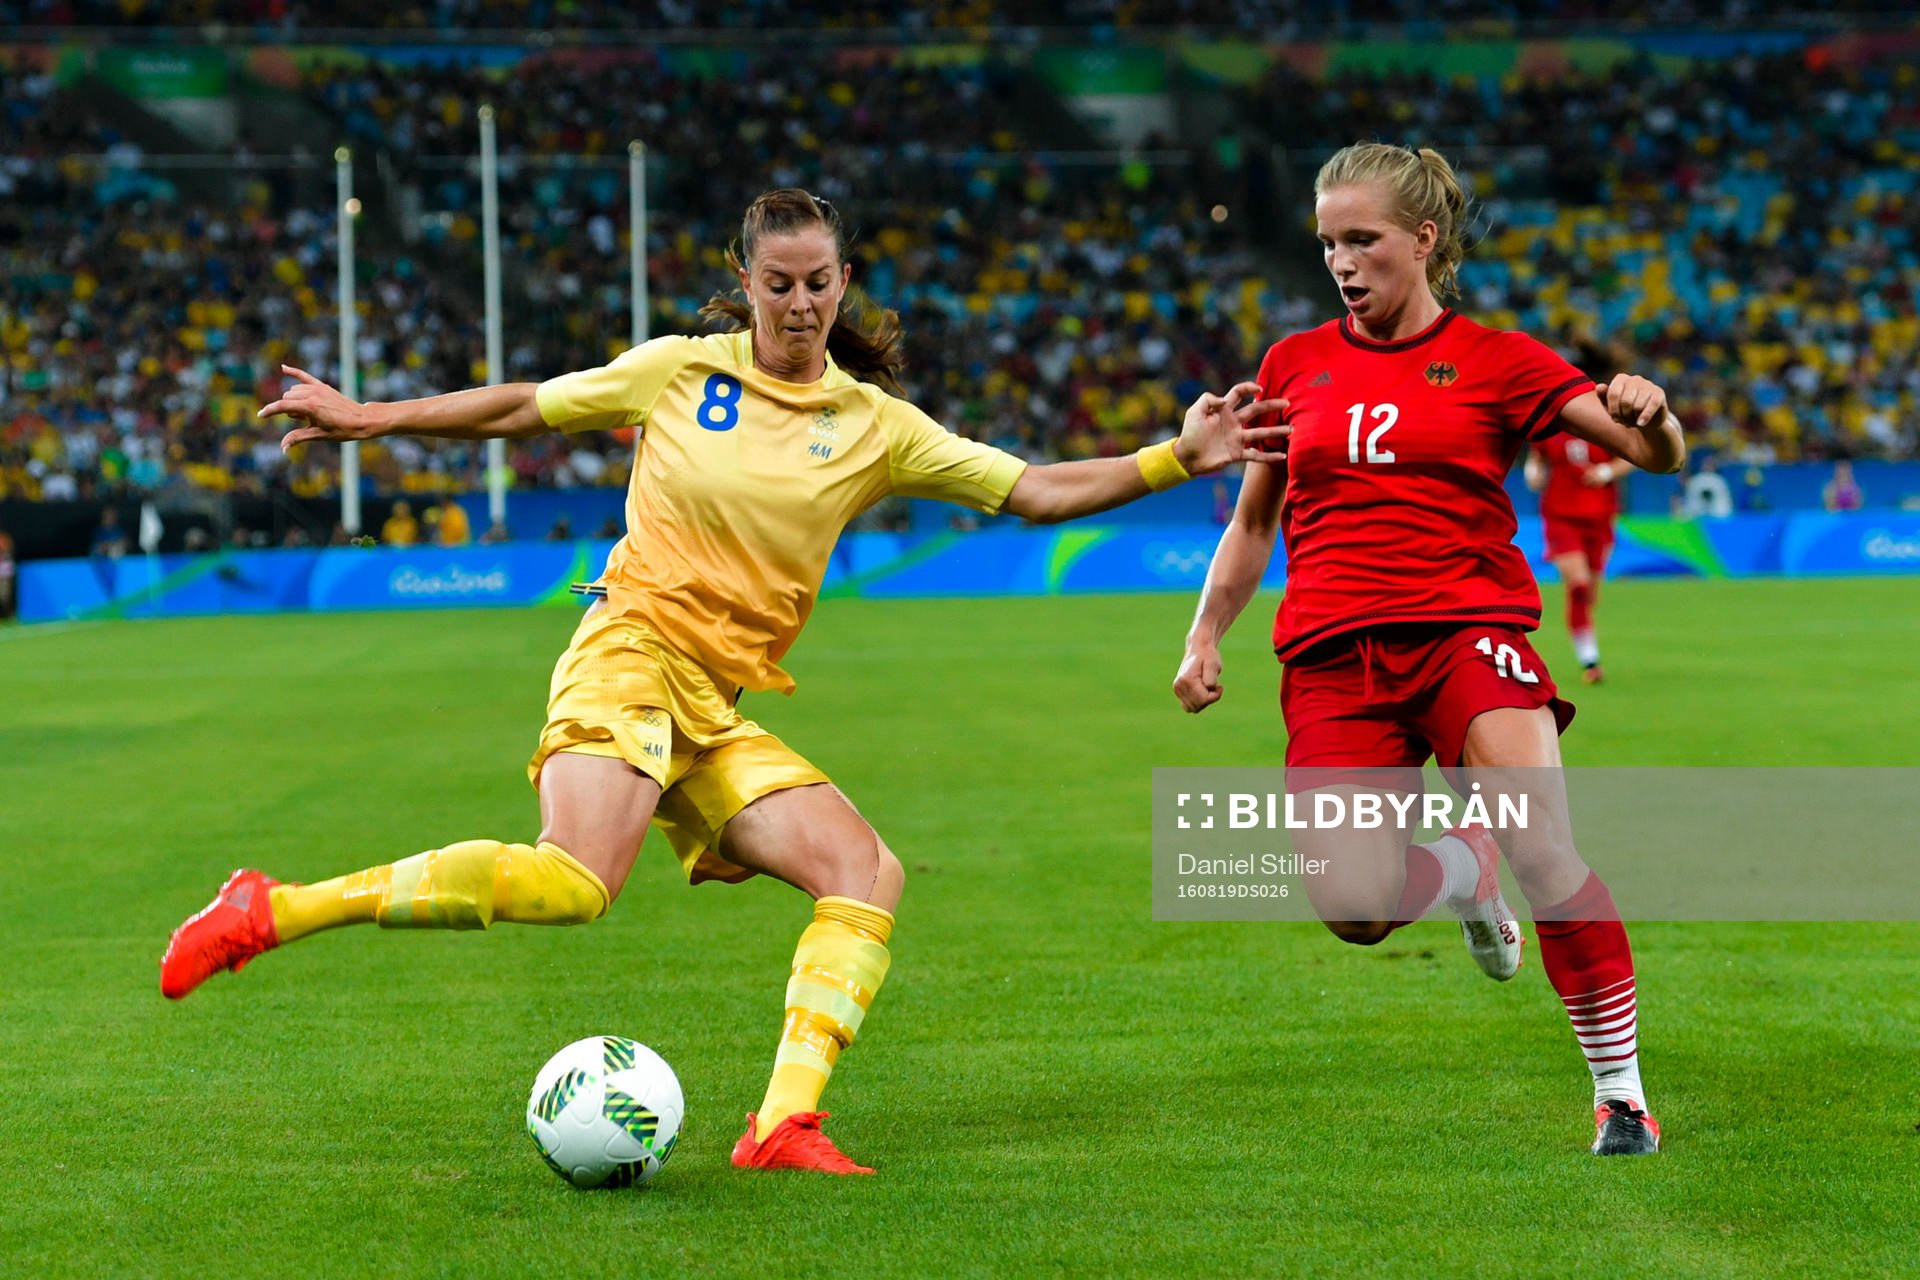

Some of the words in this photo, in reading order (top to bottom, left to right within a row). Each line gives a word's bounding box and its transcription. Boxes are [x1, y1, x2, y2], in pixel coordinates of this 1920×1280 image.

[696, 372, 742, 431] 8
[1345, 403, 1399, 463] 12
[1475, 636, 1539, 683] 12
